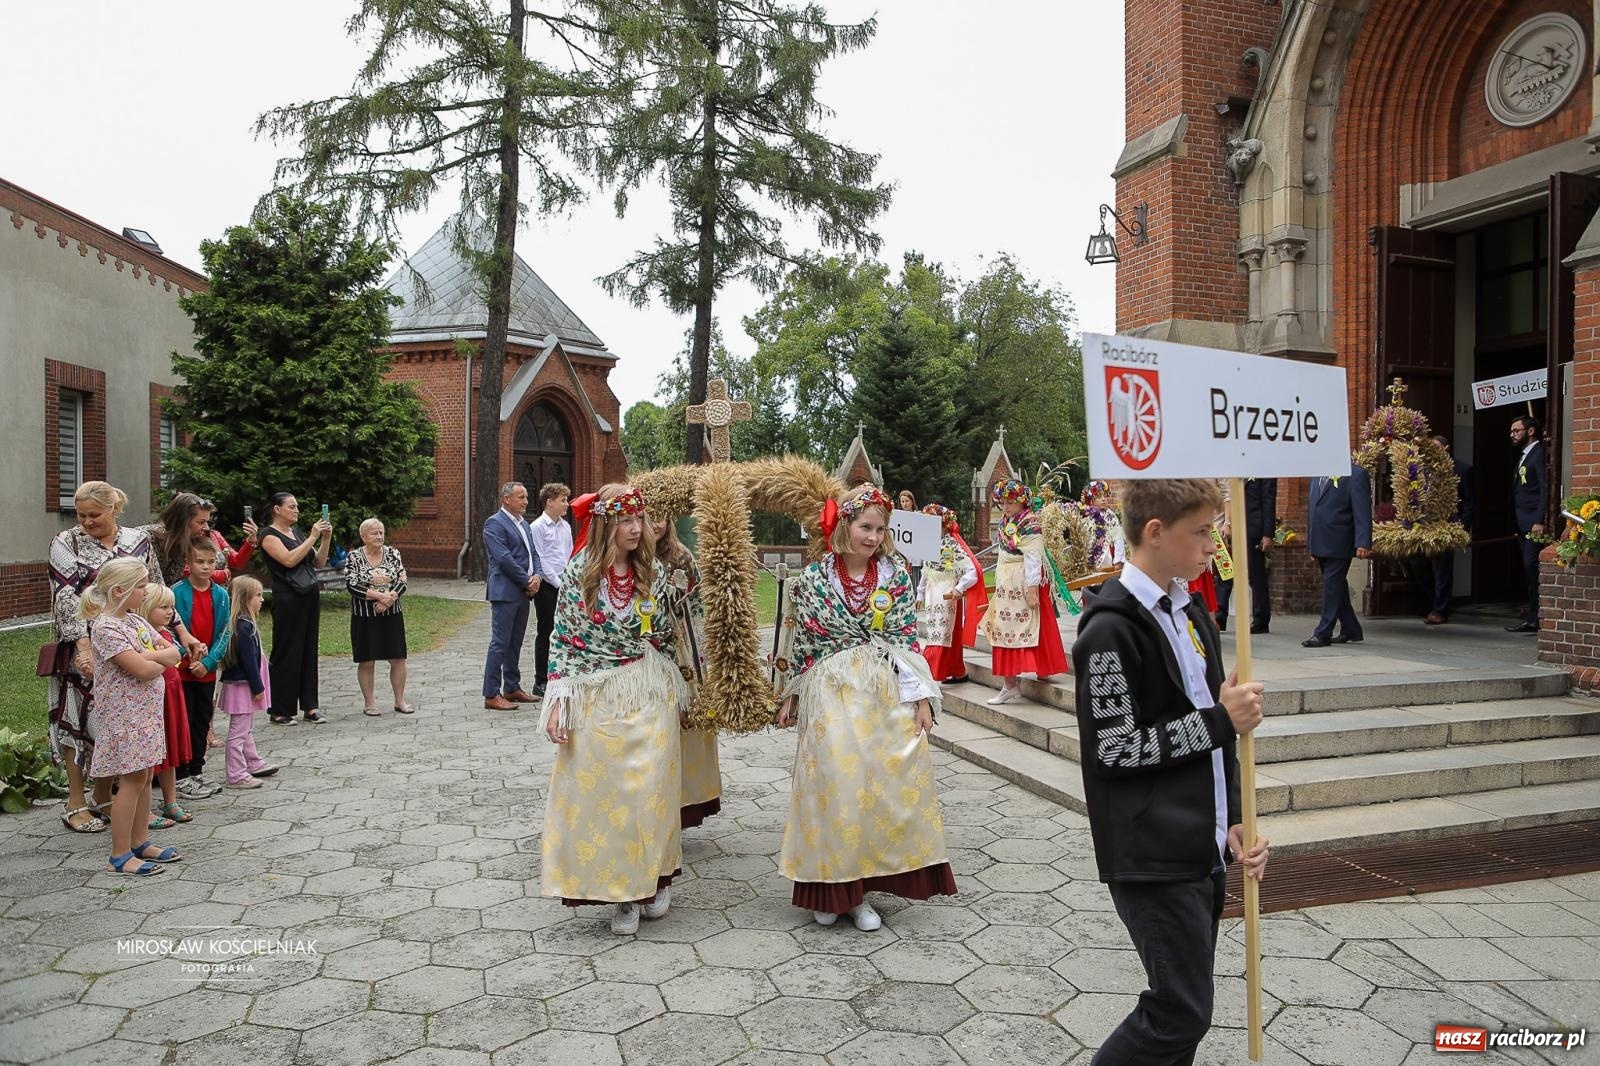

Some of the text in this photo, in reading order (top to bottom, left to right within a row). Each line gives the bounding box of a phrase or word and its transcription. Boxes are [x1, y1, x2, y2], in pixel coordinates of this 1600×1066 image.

[1102, 341, 1159, 365] Racibórz
[1210, 387, 1319, 443] Brzezie
[1165, 710, 1213, 758] BE
